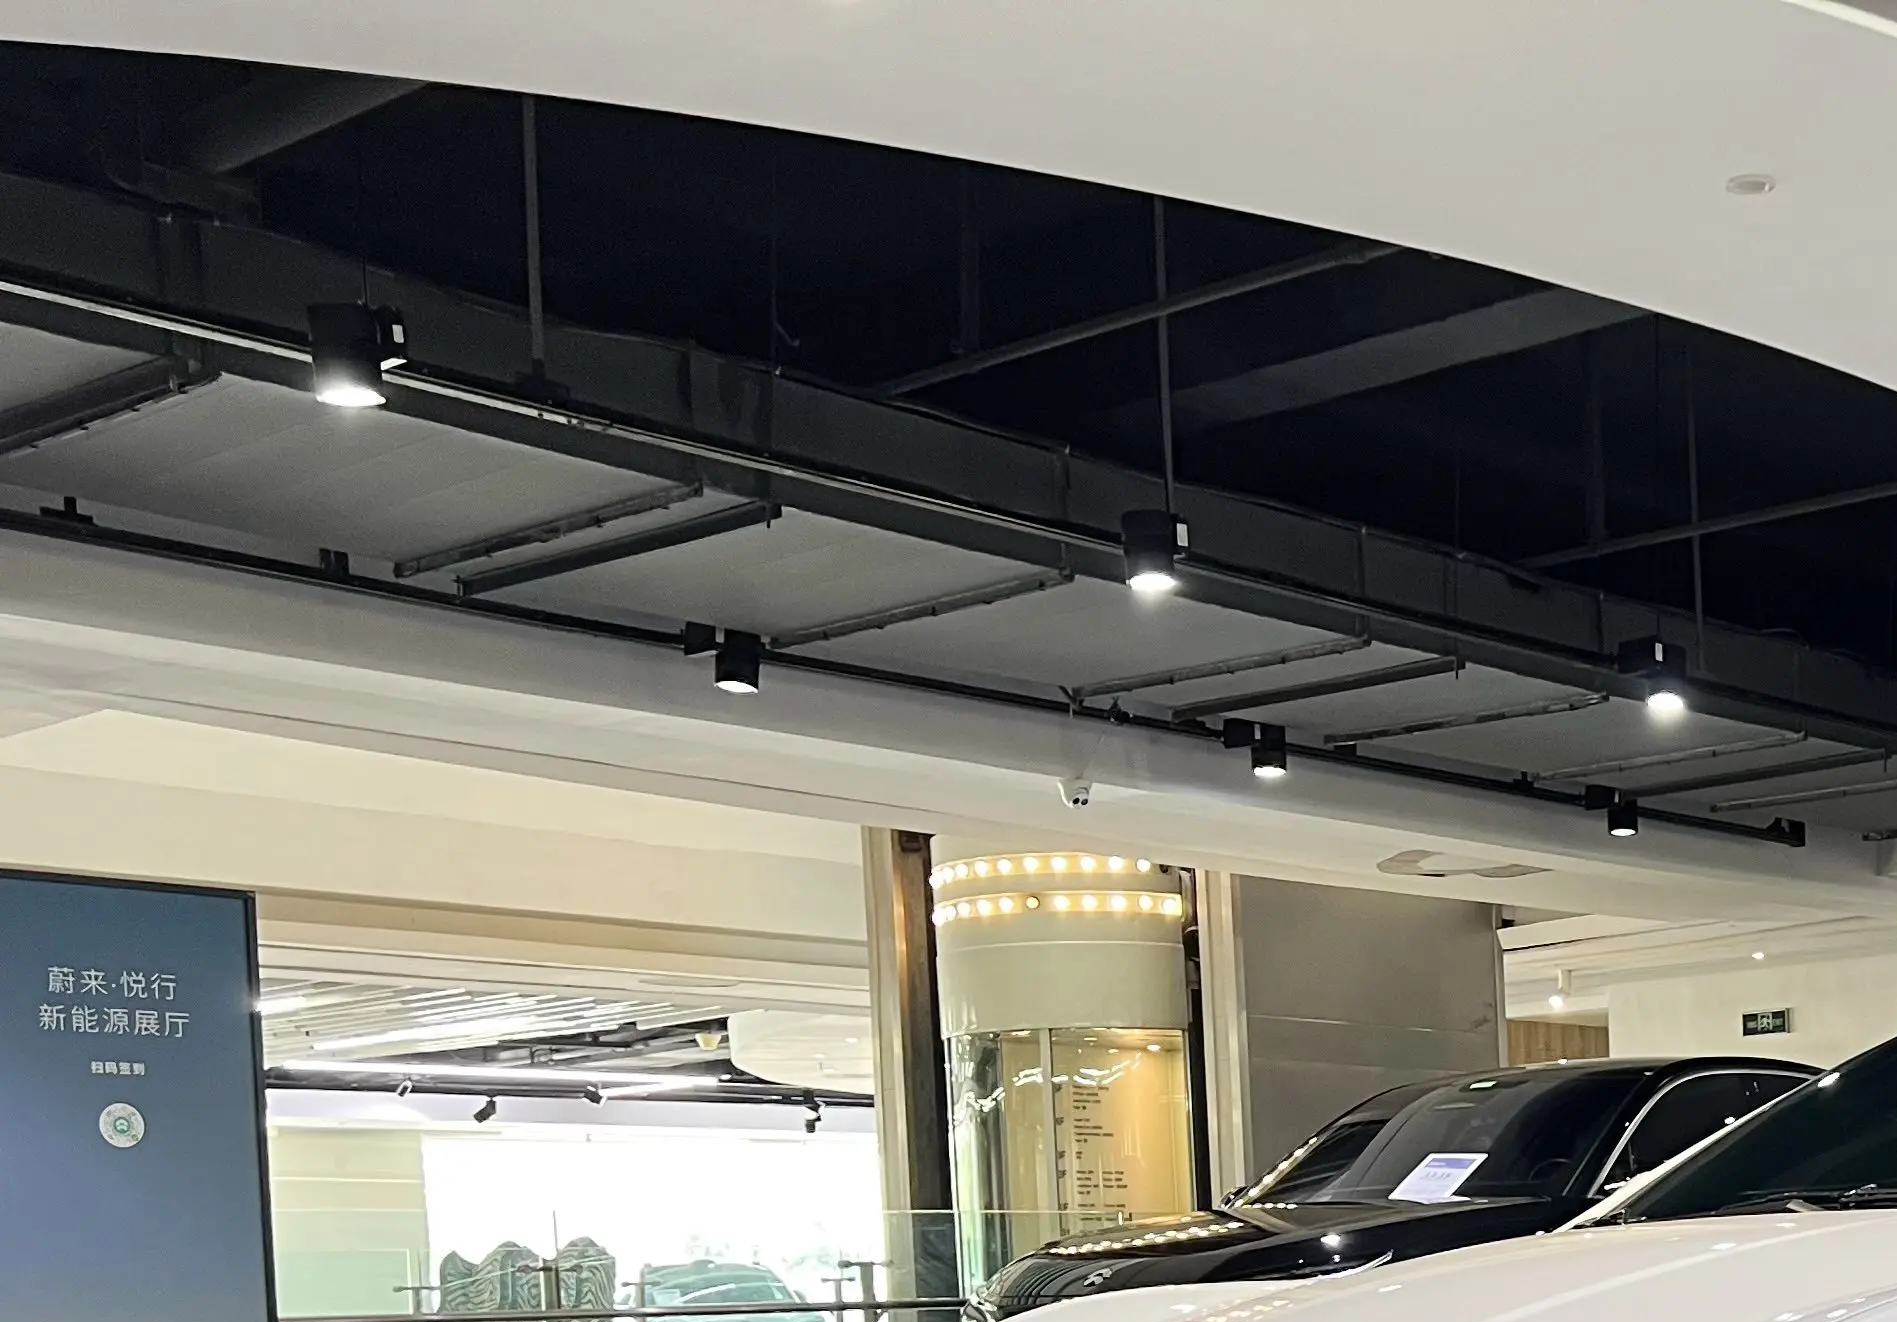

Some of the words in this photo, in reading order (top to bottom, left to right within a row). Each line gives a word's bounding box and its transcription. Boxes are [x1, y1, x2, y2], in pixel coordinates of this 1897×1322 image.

[47, 966, 177, 1000] 蔚来·悦行
[38, 1003, 190, 1038] 新能源展厅
